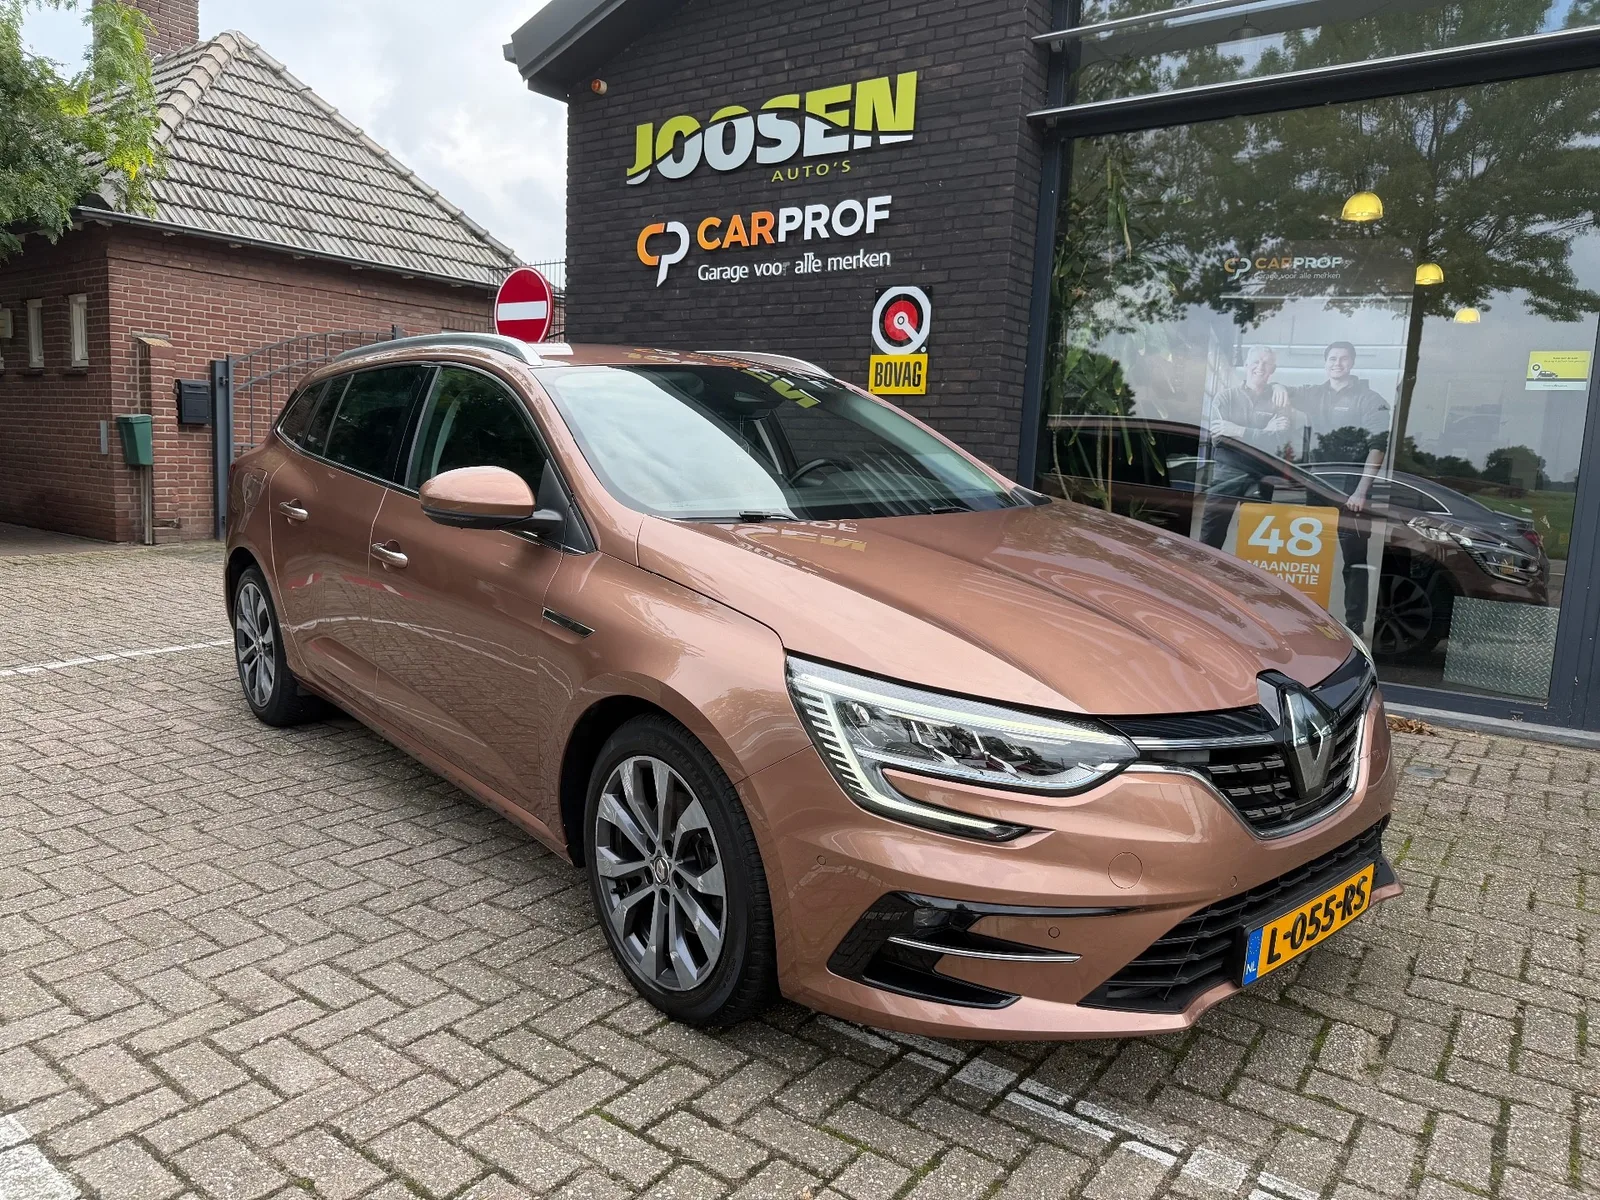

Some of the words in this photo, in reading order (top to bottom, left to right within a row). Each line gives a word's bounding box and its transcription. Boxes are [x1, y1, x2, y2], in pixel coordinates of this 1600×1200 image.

[626, 70, 917, 185] JOOSEN
[771, 160, 852, 182] AUTO'S
[697, 195, 892, 250] CARPROF
[697, 264, 749, 283] Garage
[754, 261, 790, 277] voor
[794, 252, 822, 274] alle
[827, 248, 891, 271] merken
[1255, 256, 1343, 269] CARPROF
[1300, 271, 1312, 280] alle
[1313, 271, 1341, 279] merken
[874, 361, 922, 387] BOVAG
[1247, 515, 1323, 557] 48
[1267, 875, 1368, 965] L-055-RS
[1245, 960, 1257, 976] NL
